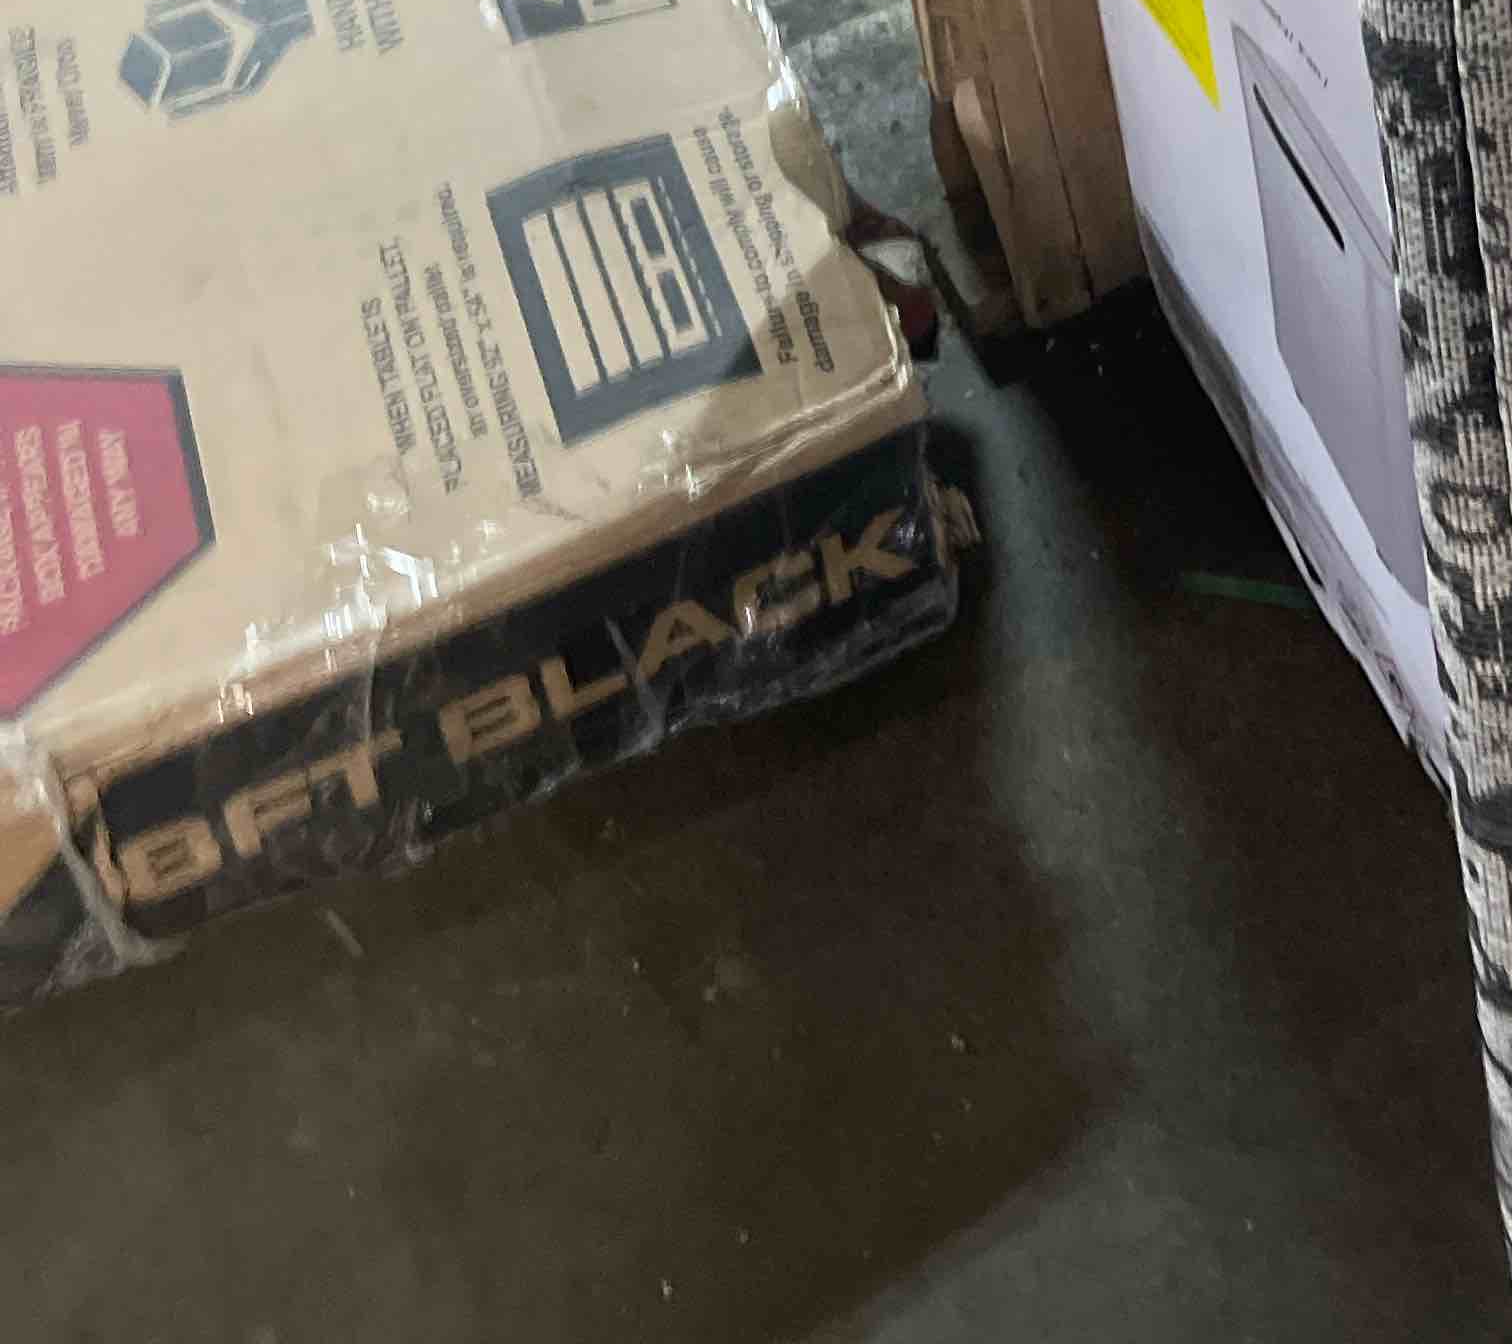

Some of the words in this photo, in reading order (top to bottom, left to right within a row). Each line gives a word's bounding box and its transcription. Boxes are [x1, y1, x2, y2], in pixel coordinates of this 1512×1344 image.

[364, 320, 400, 393] TABLE
[386, 390, 417, 456] WHEN
[488, 370, 543, 499] MEASURING
[438, 510, 914, 767] BLACK
